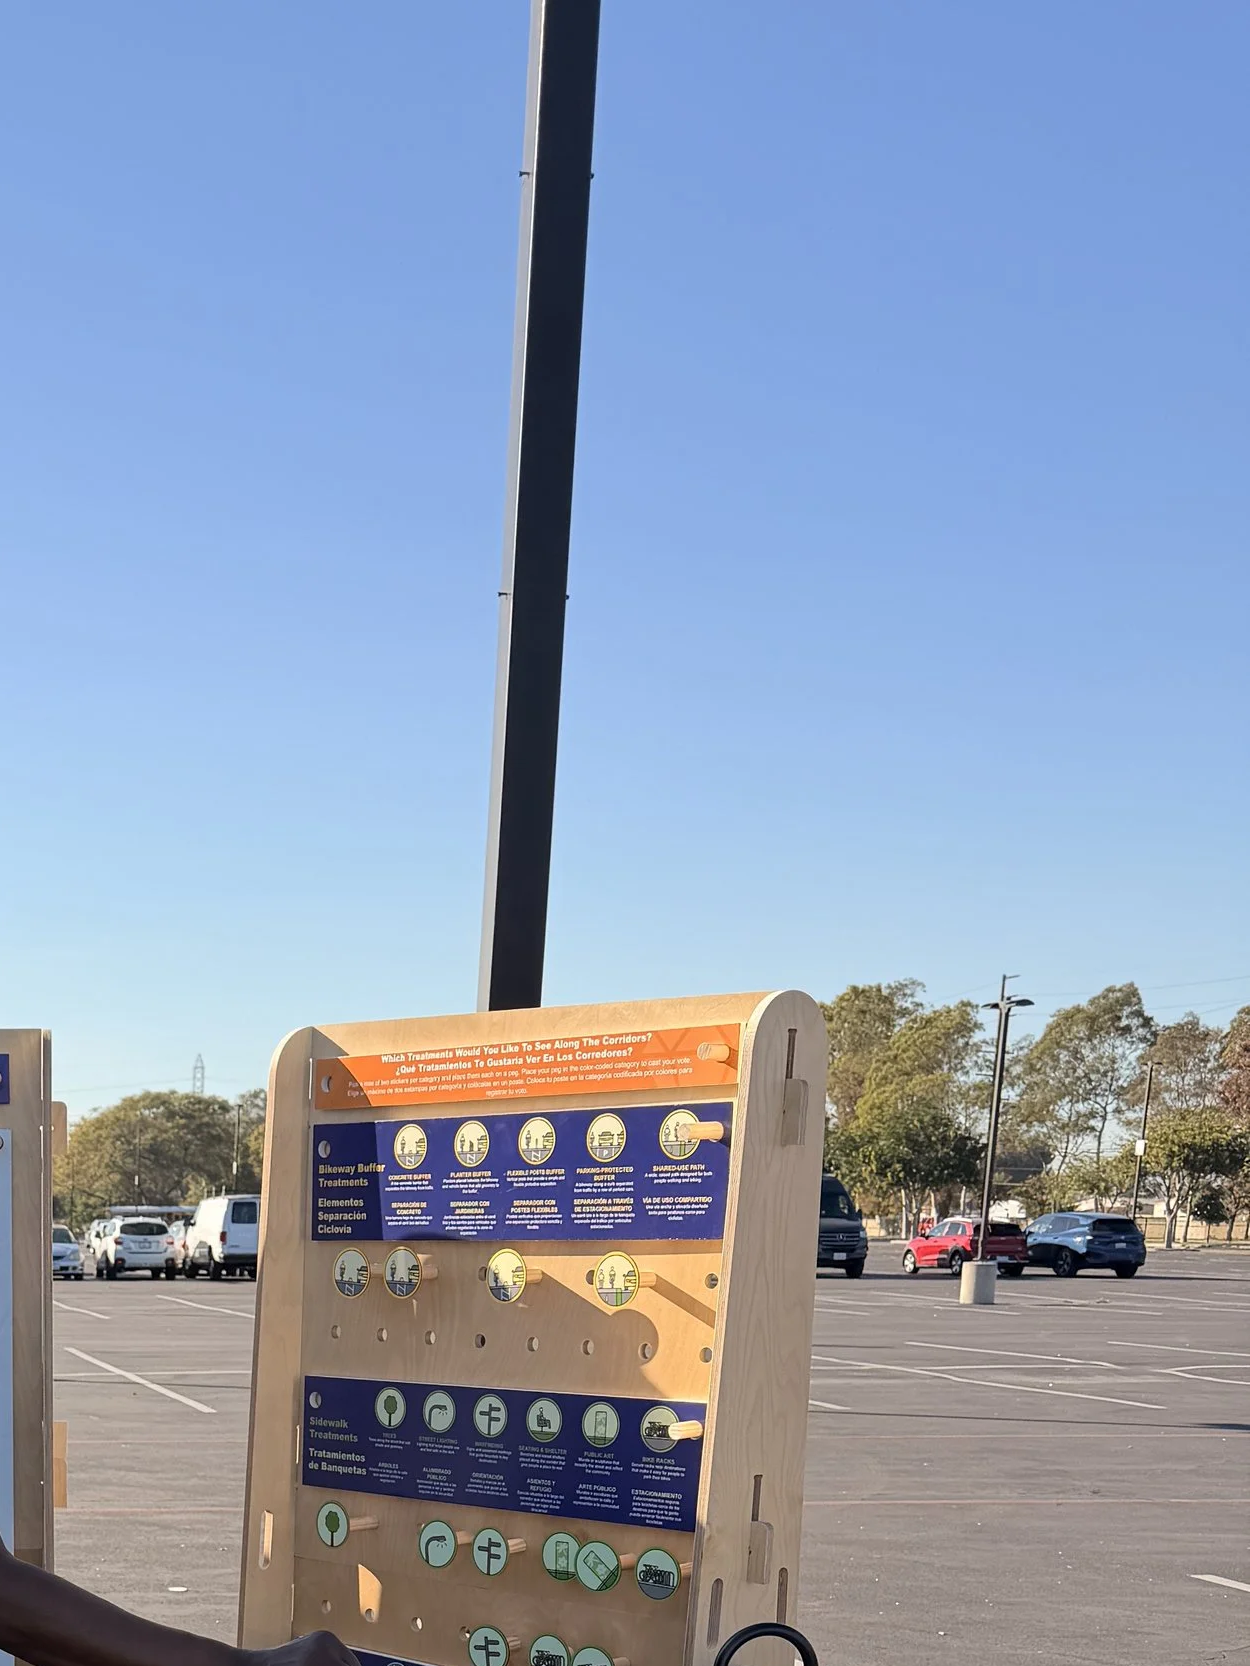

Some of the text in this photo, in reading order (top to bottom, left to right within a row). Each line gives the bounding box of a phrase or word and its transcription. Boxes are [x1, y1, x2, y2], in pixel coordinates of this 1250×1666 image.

[381, 1033, 652, 1063] Which Treatments Would You Like To See Along The Corridors?
[395, 1047, 633, 1076] ¿Qué Tratamientos Te Gustaría Ver En Los Corredores?
[318, 1163, 386, 1176] Bikeway Buffer
[318, 1178, 369, 1188] Treatments
[318, 1198, 364, 1208] Elementos
[318, 1211, 367, 1223] Separación
[309, 1416, 349, 1429] Sidewalk
[309, 1429, 358, 1443] Treatments
[308, 1447, 366, 1463] Tratamientos
[308, 1461, 319, 1470] de
[321, 1462, 367, 1476] Banquetas
[530, 1485, 552, 1493] REFUGIO
[631, 1488, 683, 1500] ESTACIONAMIENTO
